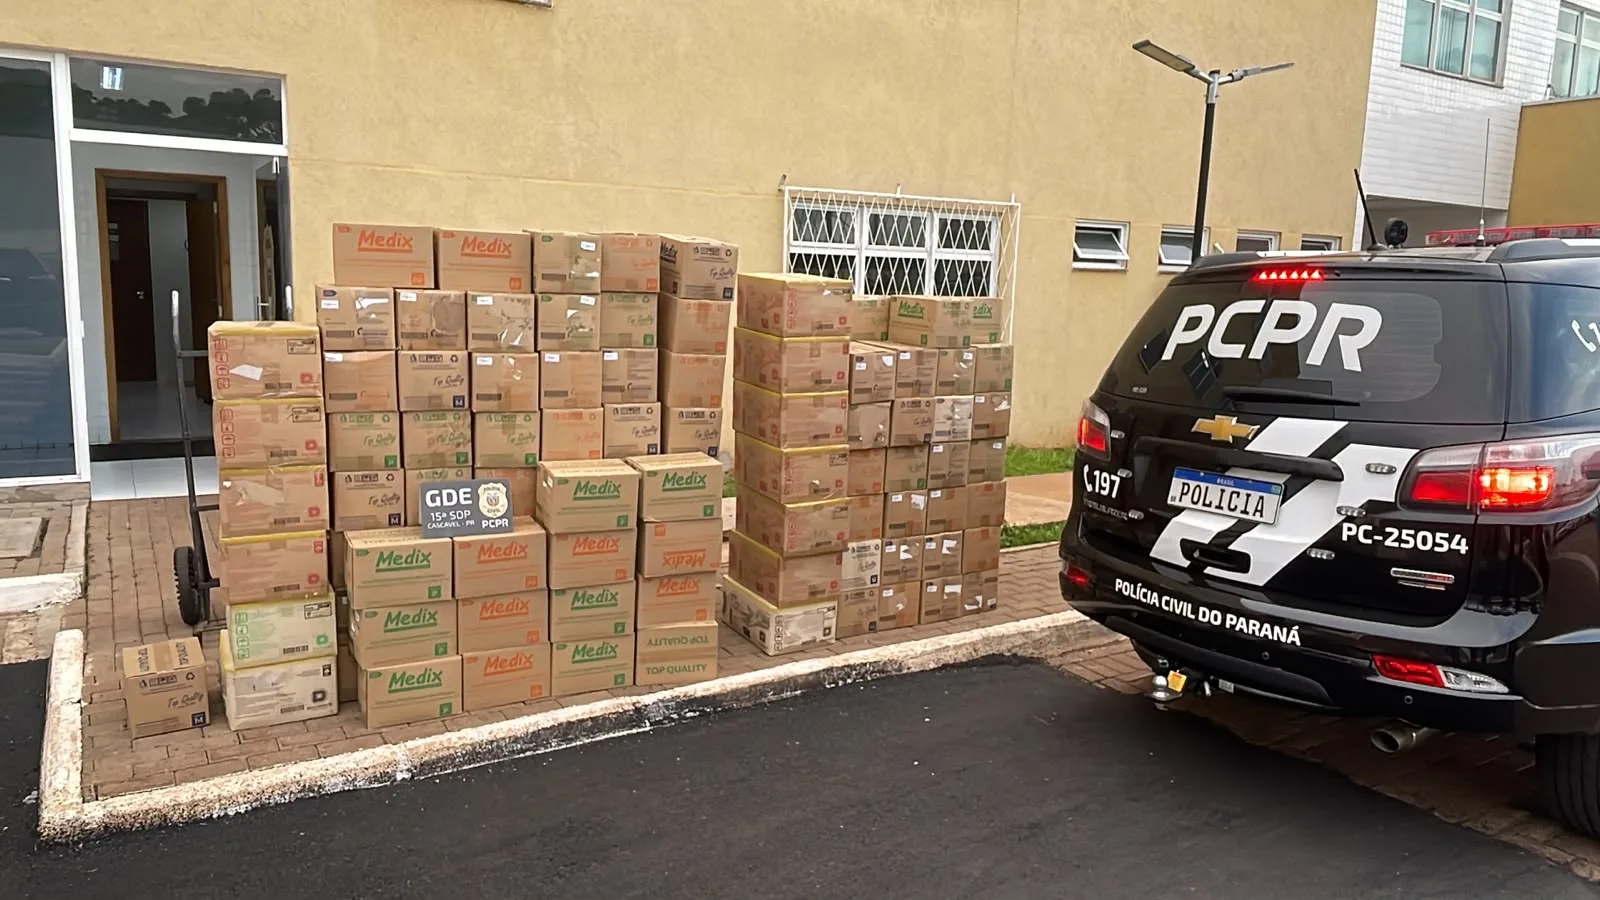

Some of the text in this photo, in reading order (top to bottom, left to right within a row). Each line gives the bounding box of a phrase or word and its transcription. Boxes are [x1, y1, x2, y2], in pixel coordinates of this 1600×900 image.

[358, 230, 413, 249] Medix
[461, 236, 512, 254] Medix
[1161, 300, 1383, 372] PCPR
[573, 480, 621, 497] Medix
[662, 471, 707, 488] Medix
[1093, 470, 1120, 499] 197
[426, 488, 472, 507] GDE
[1179, 482, 1265, 518] POLICIA
[449, 510, 471, 520] SDP
[482, 519, 509, 529] PCPR
[427, 521, 460, 529] CASCAVEL
[573, 535, 620, 552] Medix
[1342, 522, 1469, 554] PC-25054
[376, 549, 432, 568] Medix
[477, 543, 528, 561] Medix
[662, 552, 705, 568] Medix
[657, 576, 701, 593] Medix
[571, 589, 619, 606] Medix
[480, 598, 530, 617] Medix
[1115, 578, 1301, 646] POLÍCIA CIVIL DO PARANÁ
[384, 608, 438, 629] Medix
[572, 642, 619, 660] Medix
[484, 652, 534, 673] Medix
[646, 663, 707, 675] TOP QUALITY
[388, 668, 443, 690] Medix
